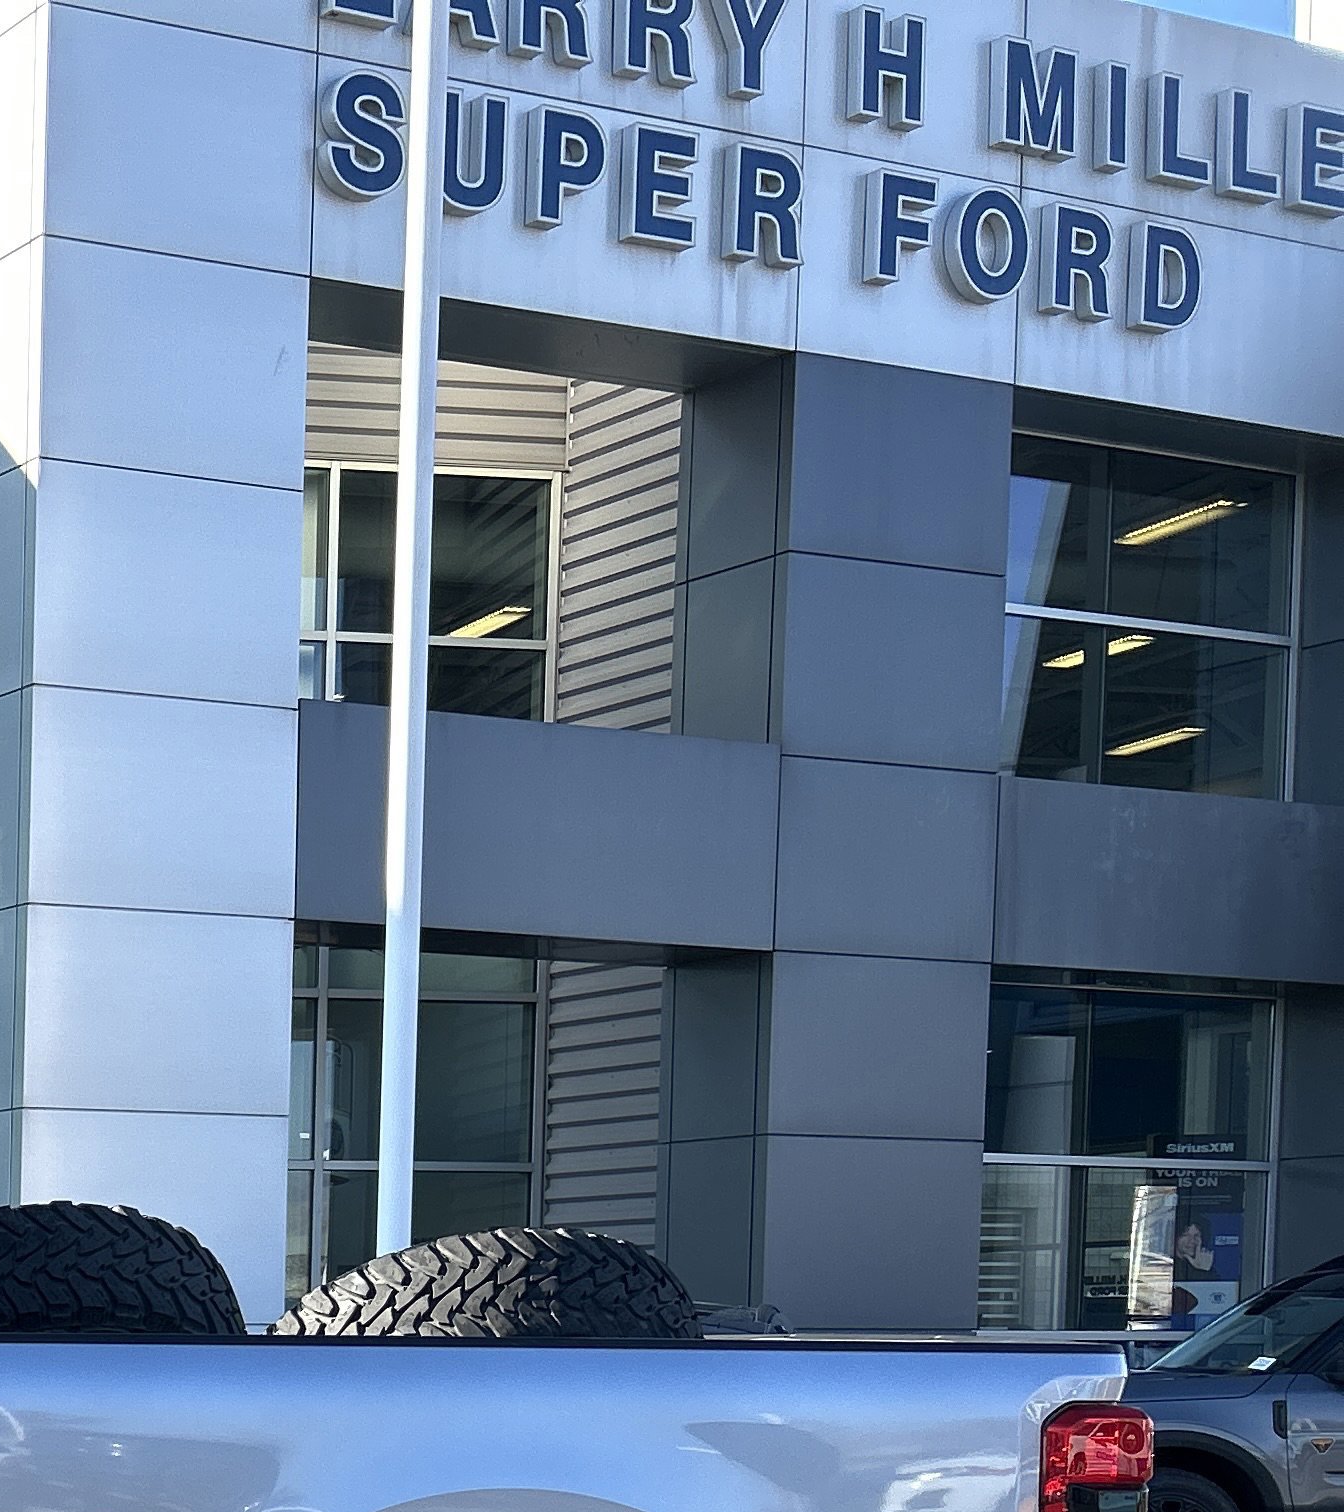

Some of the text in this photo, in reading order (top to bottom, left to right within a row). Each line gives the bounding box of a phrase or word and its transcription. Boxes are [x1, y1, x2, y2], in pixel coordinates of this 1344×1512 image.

[319, 0, 787, 99] RRY
[847, 4, 926, 131] H
[317, 69, 1202, 334] SUPER FORD
[1166, 1142, 1234, 1153] SiriusXM
[1179, 1177, 1218, 1187] IS ON
